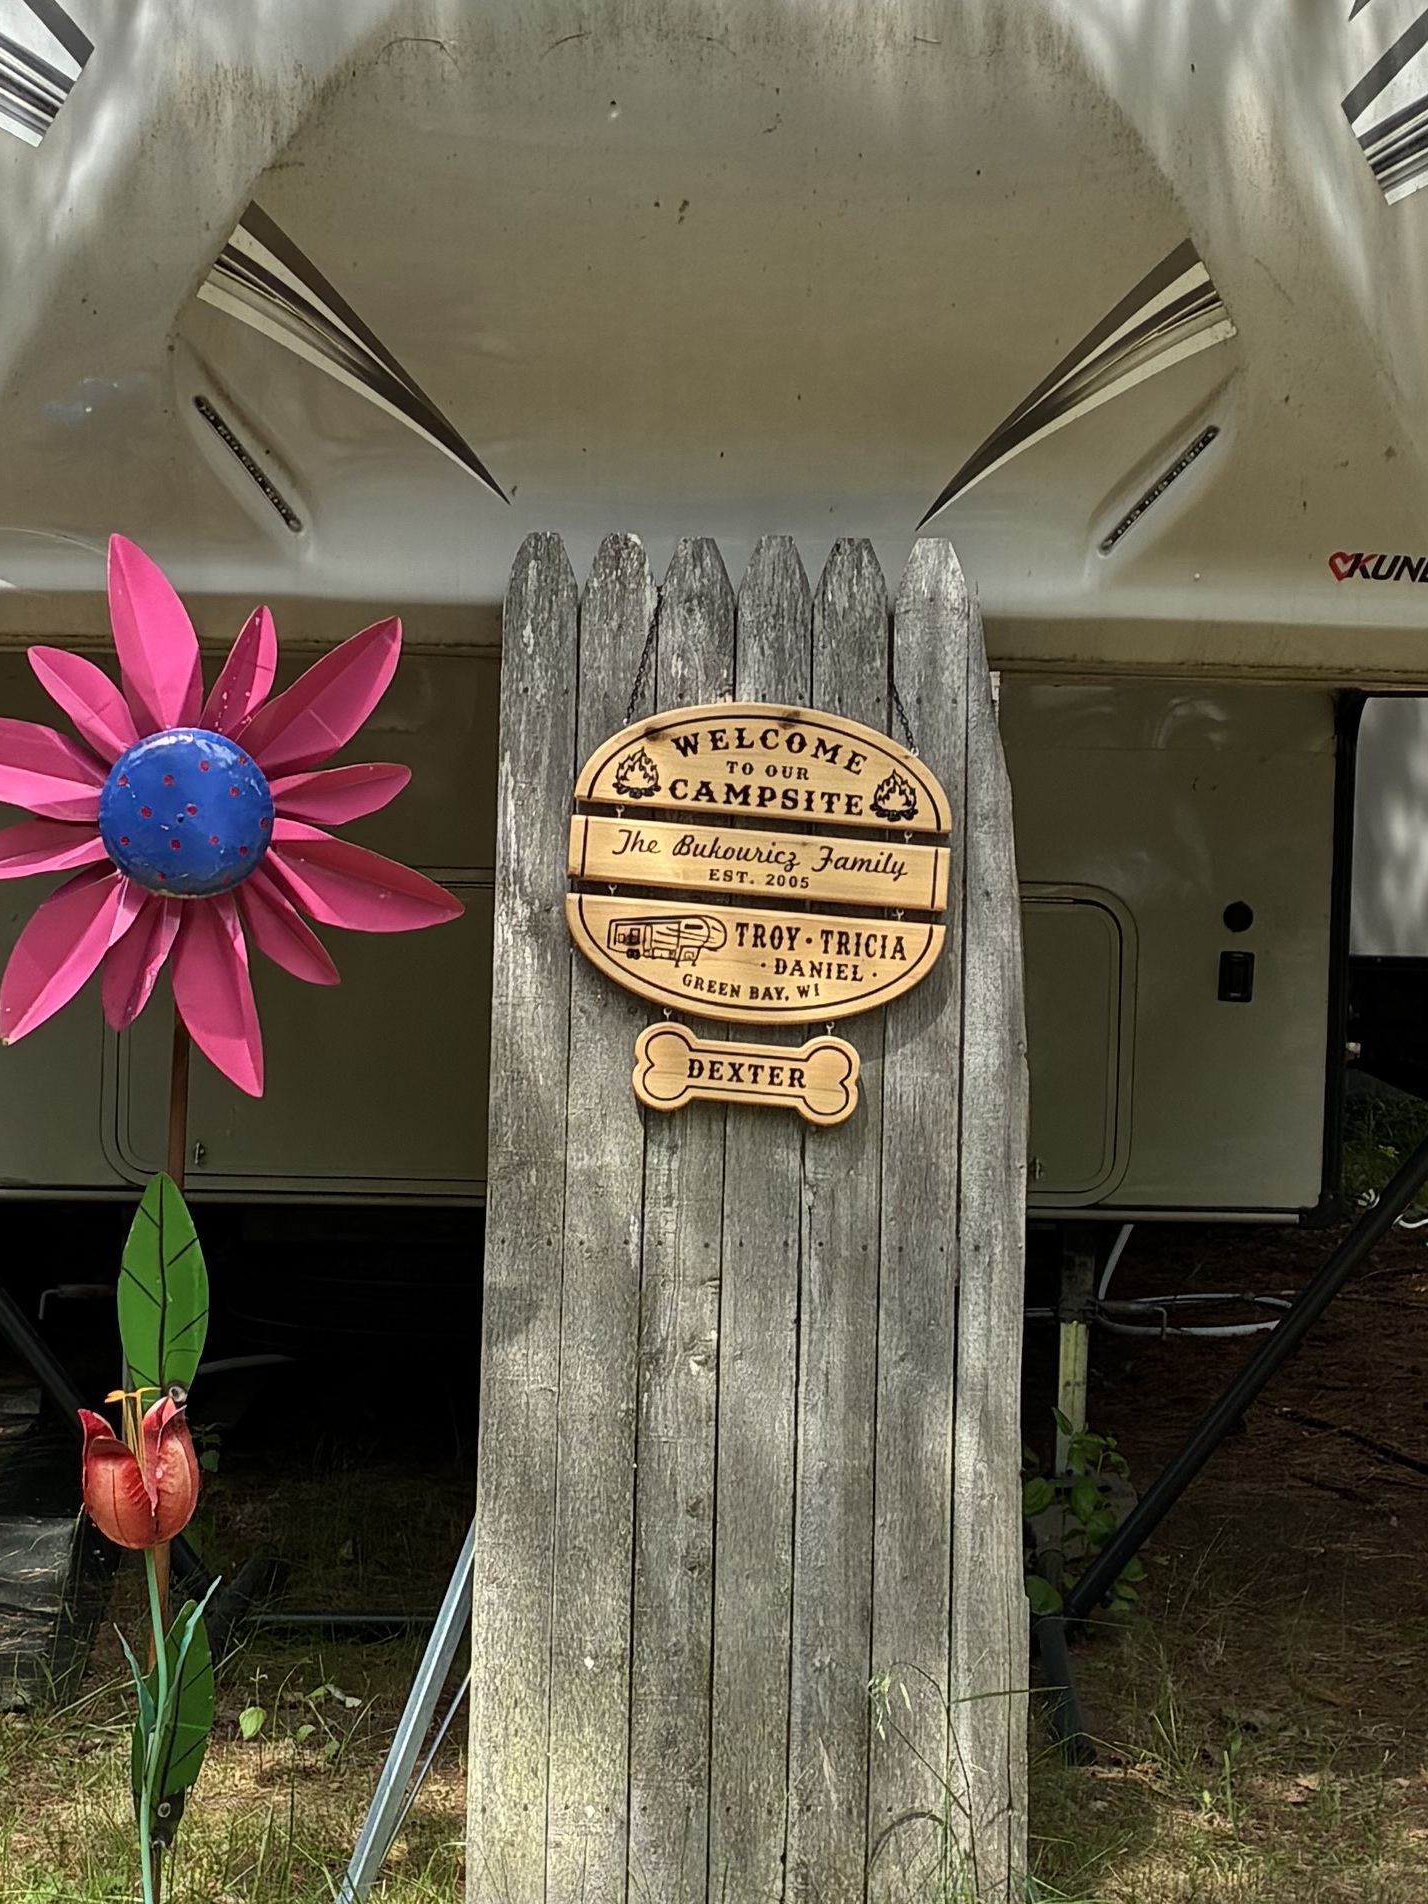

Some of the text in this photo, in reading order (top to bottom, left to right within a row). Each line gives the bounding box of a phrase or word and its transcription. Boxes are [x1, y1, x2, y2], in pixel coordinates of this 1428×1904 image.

[671, 726, 868, 776] WELCOME
[726, 760, 810, 781] TO OUR
[668, 778, 864, 817] CAMPSITE
[611, 828, 661, 856] The
[811, 845, 909, 882] Family
[708, 868, 810, 890] EST. 2005
[735, 921, 907, 961] TROY TRICIA
[773, 957, 864, 983] DANIEL
[682, 973, 821, 1002] GREEN BAY, WI
[686, 1057, 808, 1089] DEXTER
